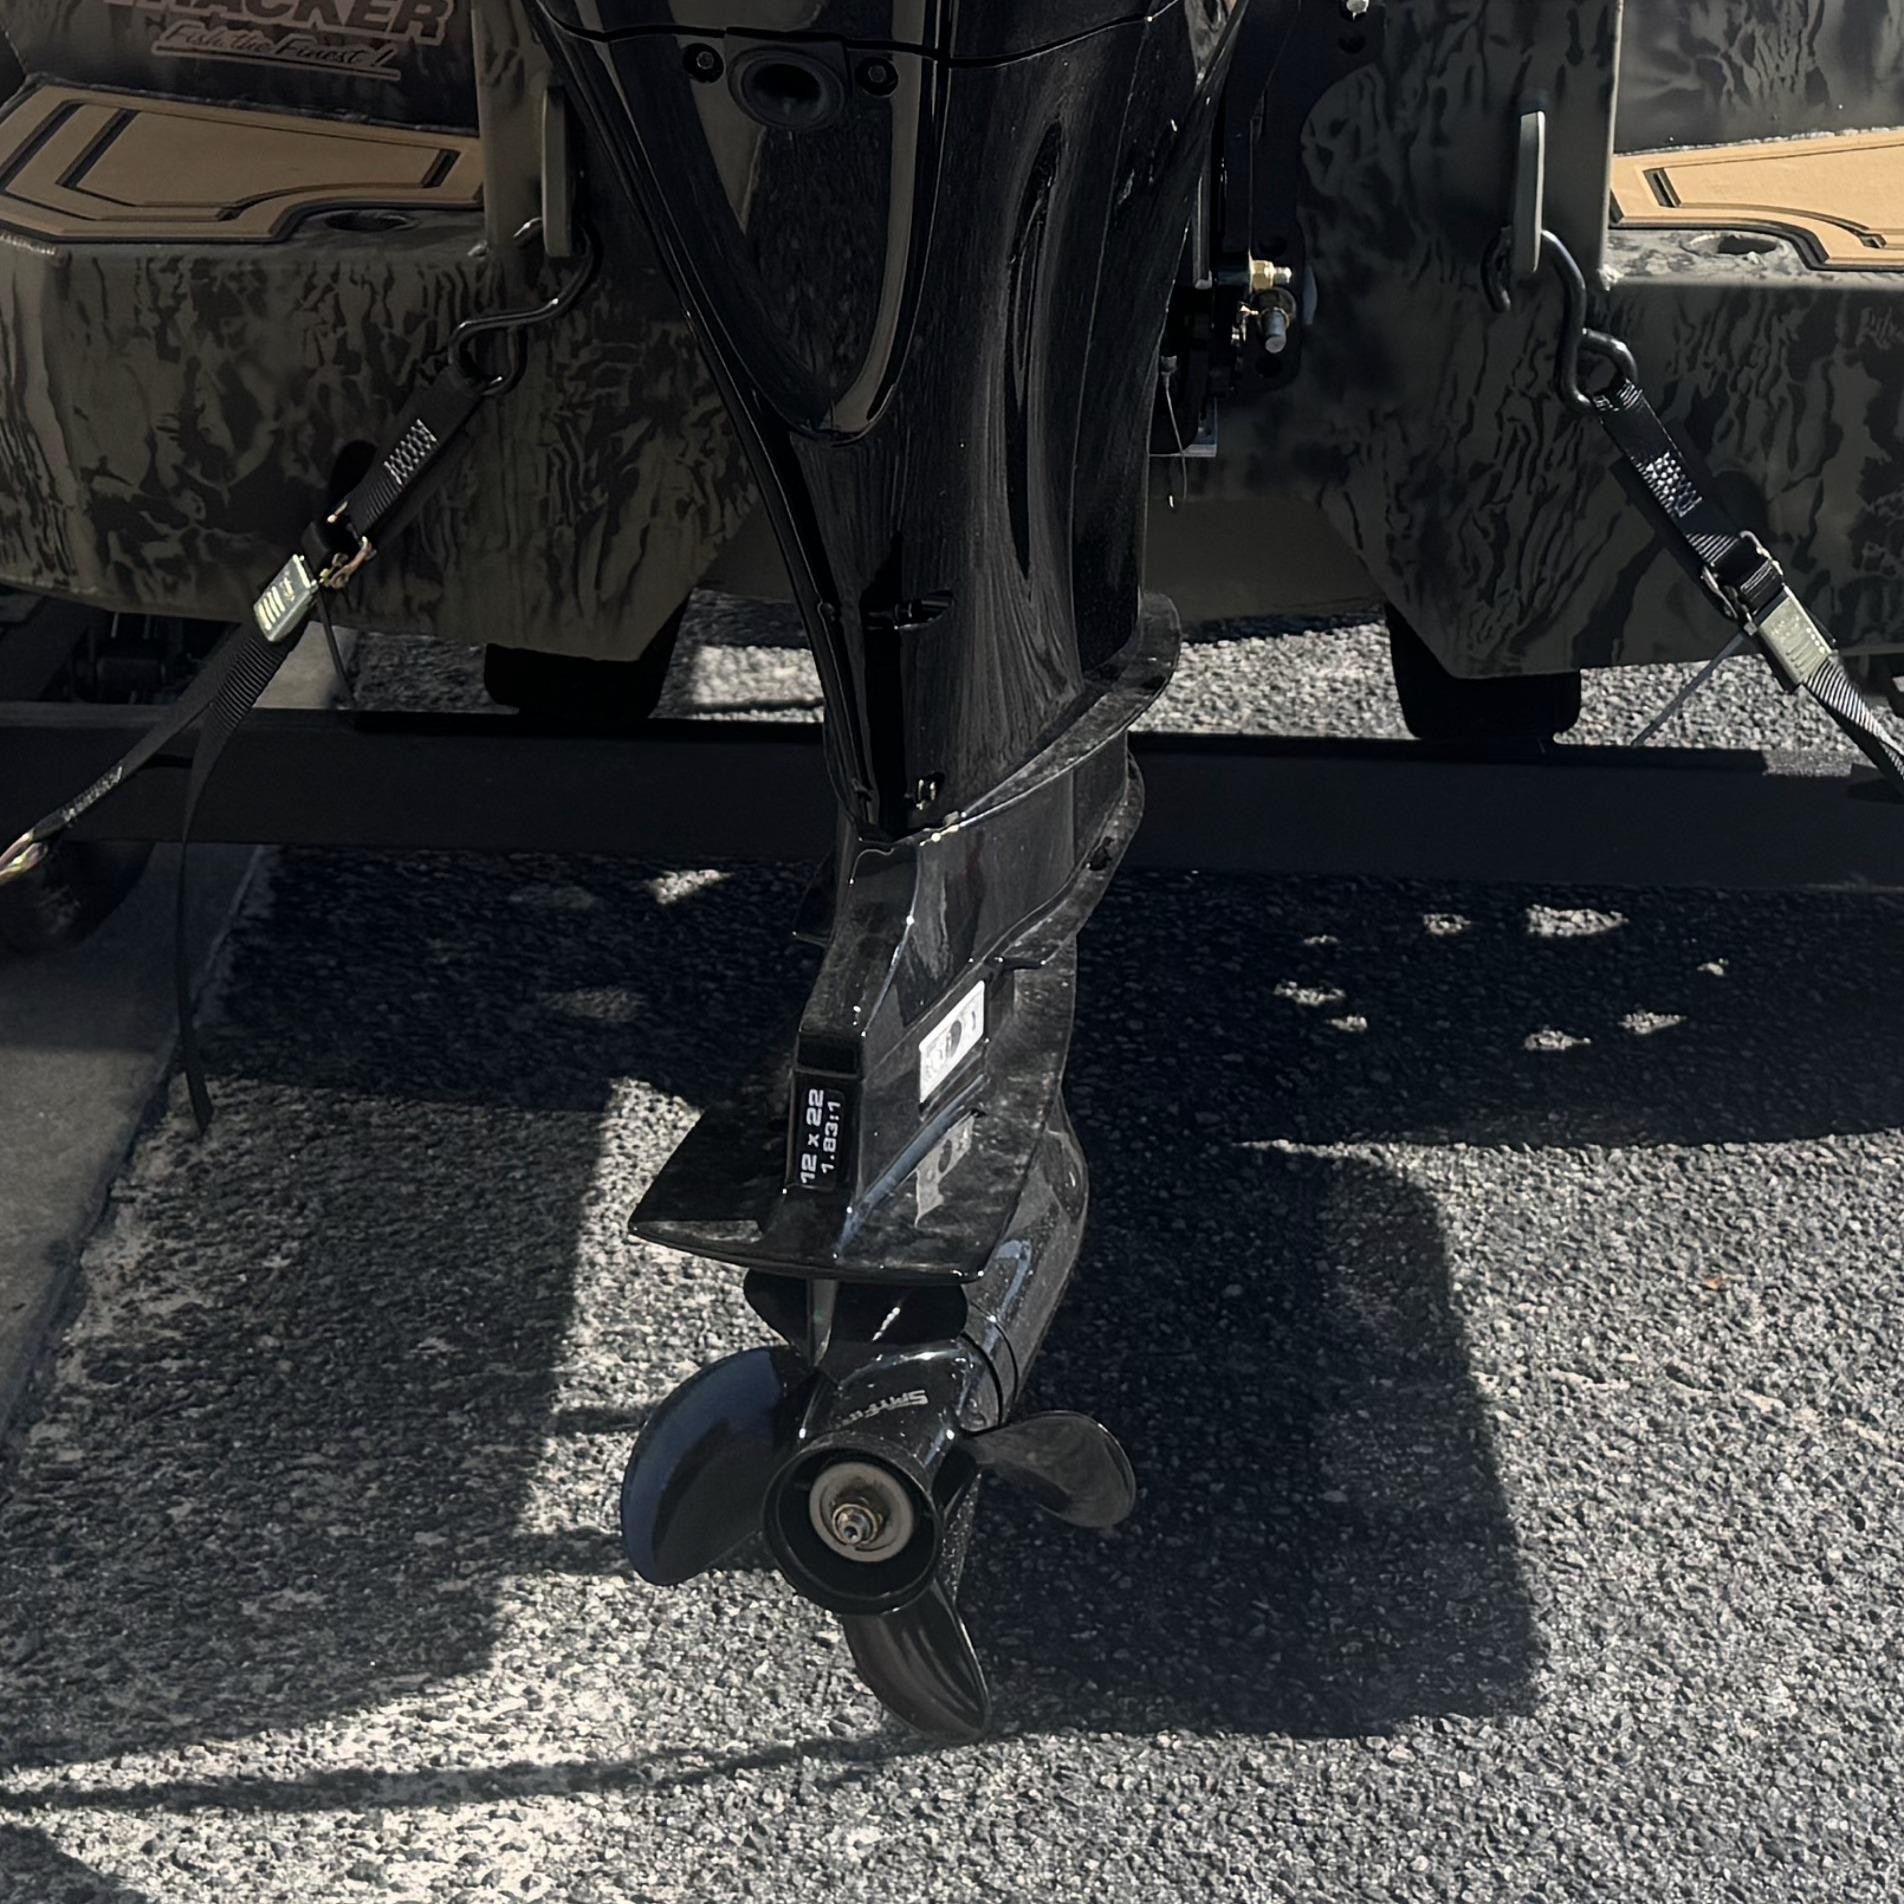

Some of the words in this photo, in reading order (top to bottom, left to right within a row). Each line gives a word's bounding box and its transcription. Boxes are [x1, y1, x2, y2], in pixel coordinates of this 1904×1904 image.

[806, 1088, 824, 1127] 22
[820, 1100, 841, 1174] 1.83:1
[800, 1153, 818, 1184] 12
